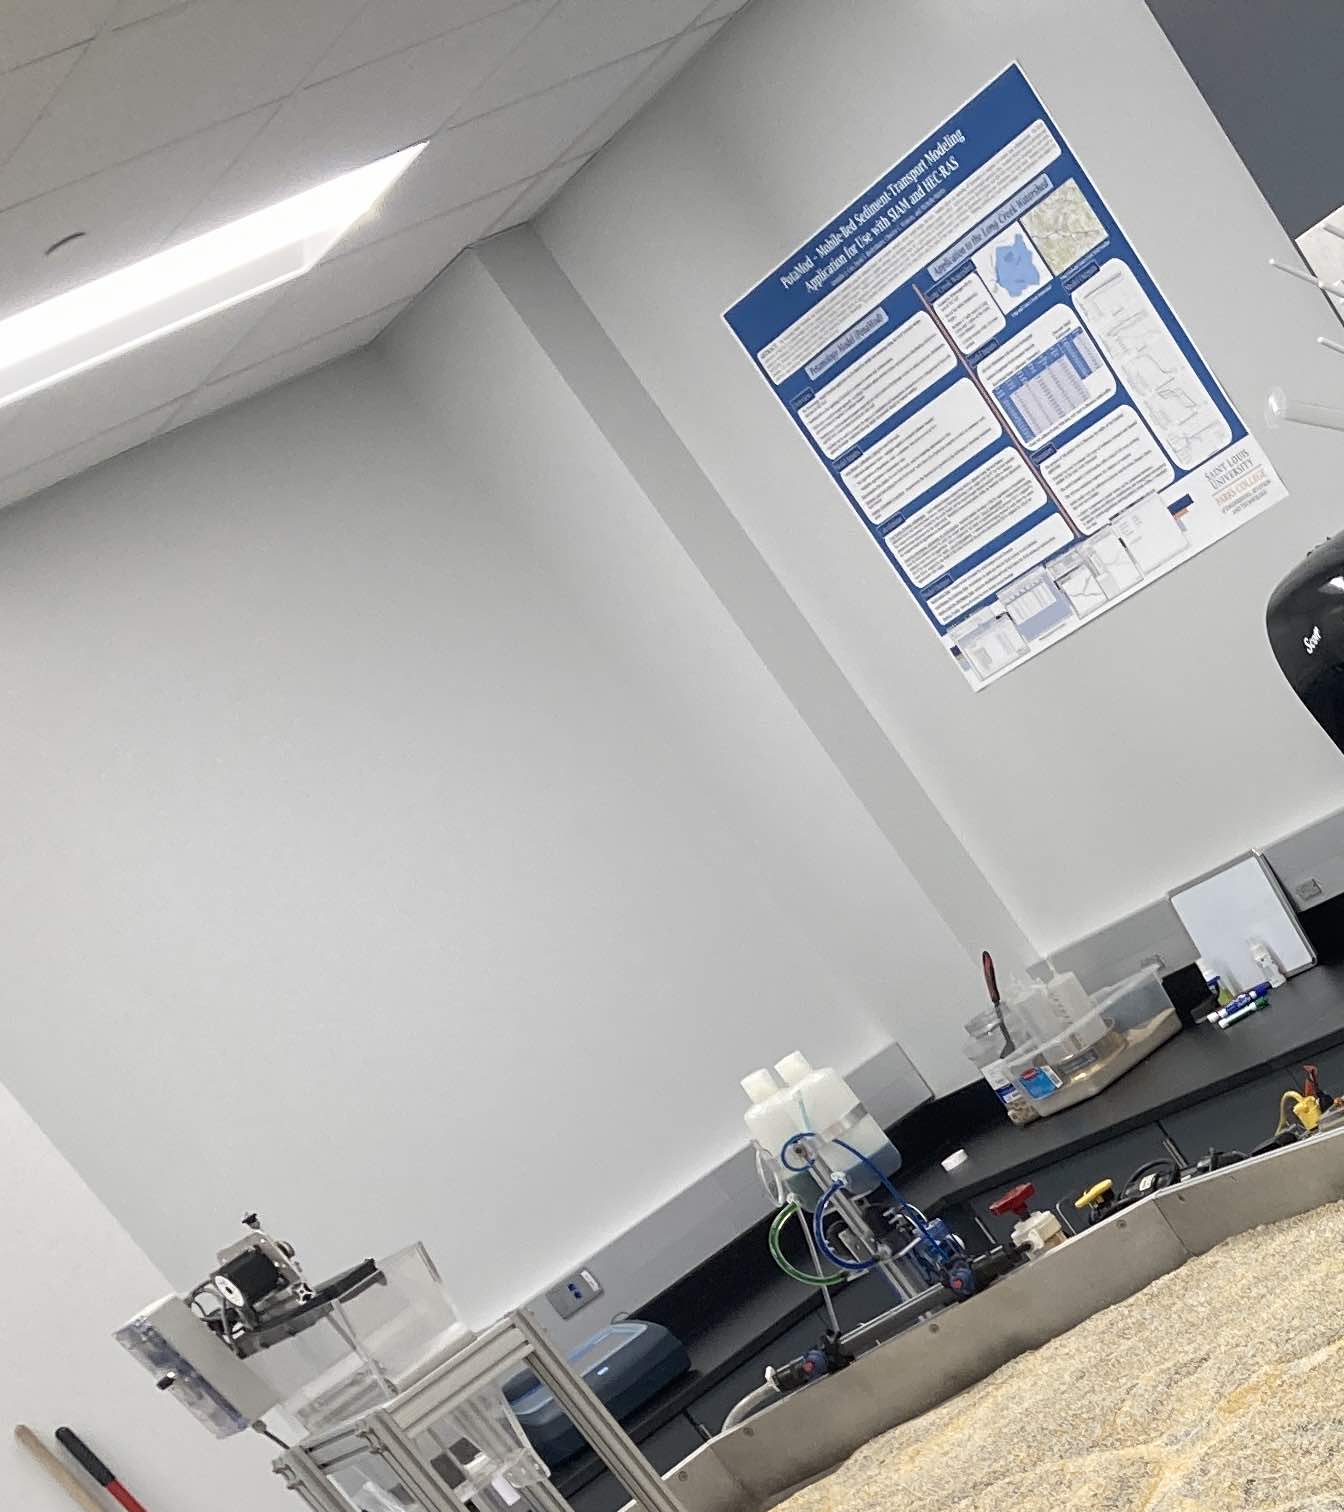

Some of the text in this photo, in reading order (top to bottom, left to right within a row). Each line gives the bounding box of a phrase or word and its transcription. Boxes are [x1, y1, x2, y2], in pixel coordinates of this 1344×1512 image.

[779, 254, 815, 289] PotaMod
[815, 217, 859, 259] Mobile-Bed
[853, 158, 929, 227] Sediment-Transport
[923, 129, 966, 166] Modeling
[804, 155, 960, 293] Application for Use with SIAM and HEC-RAS
[970, 233, 983, 246] the
[1208, 455, 1254, 491] UNIVERSITY
